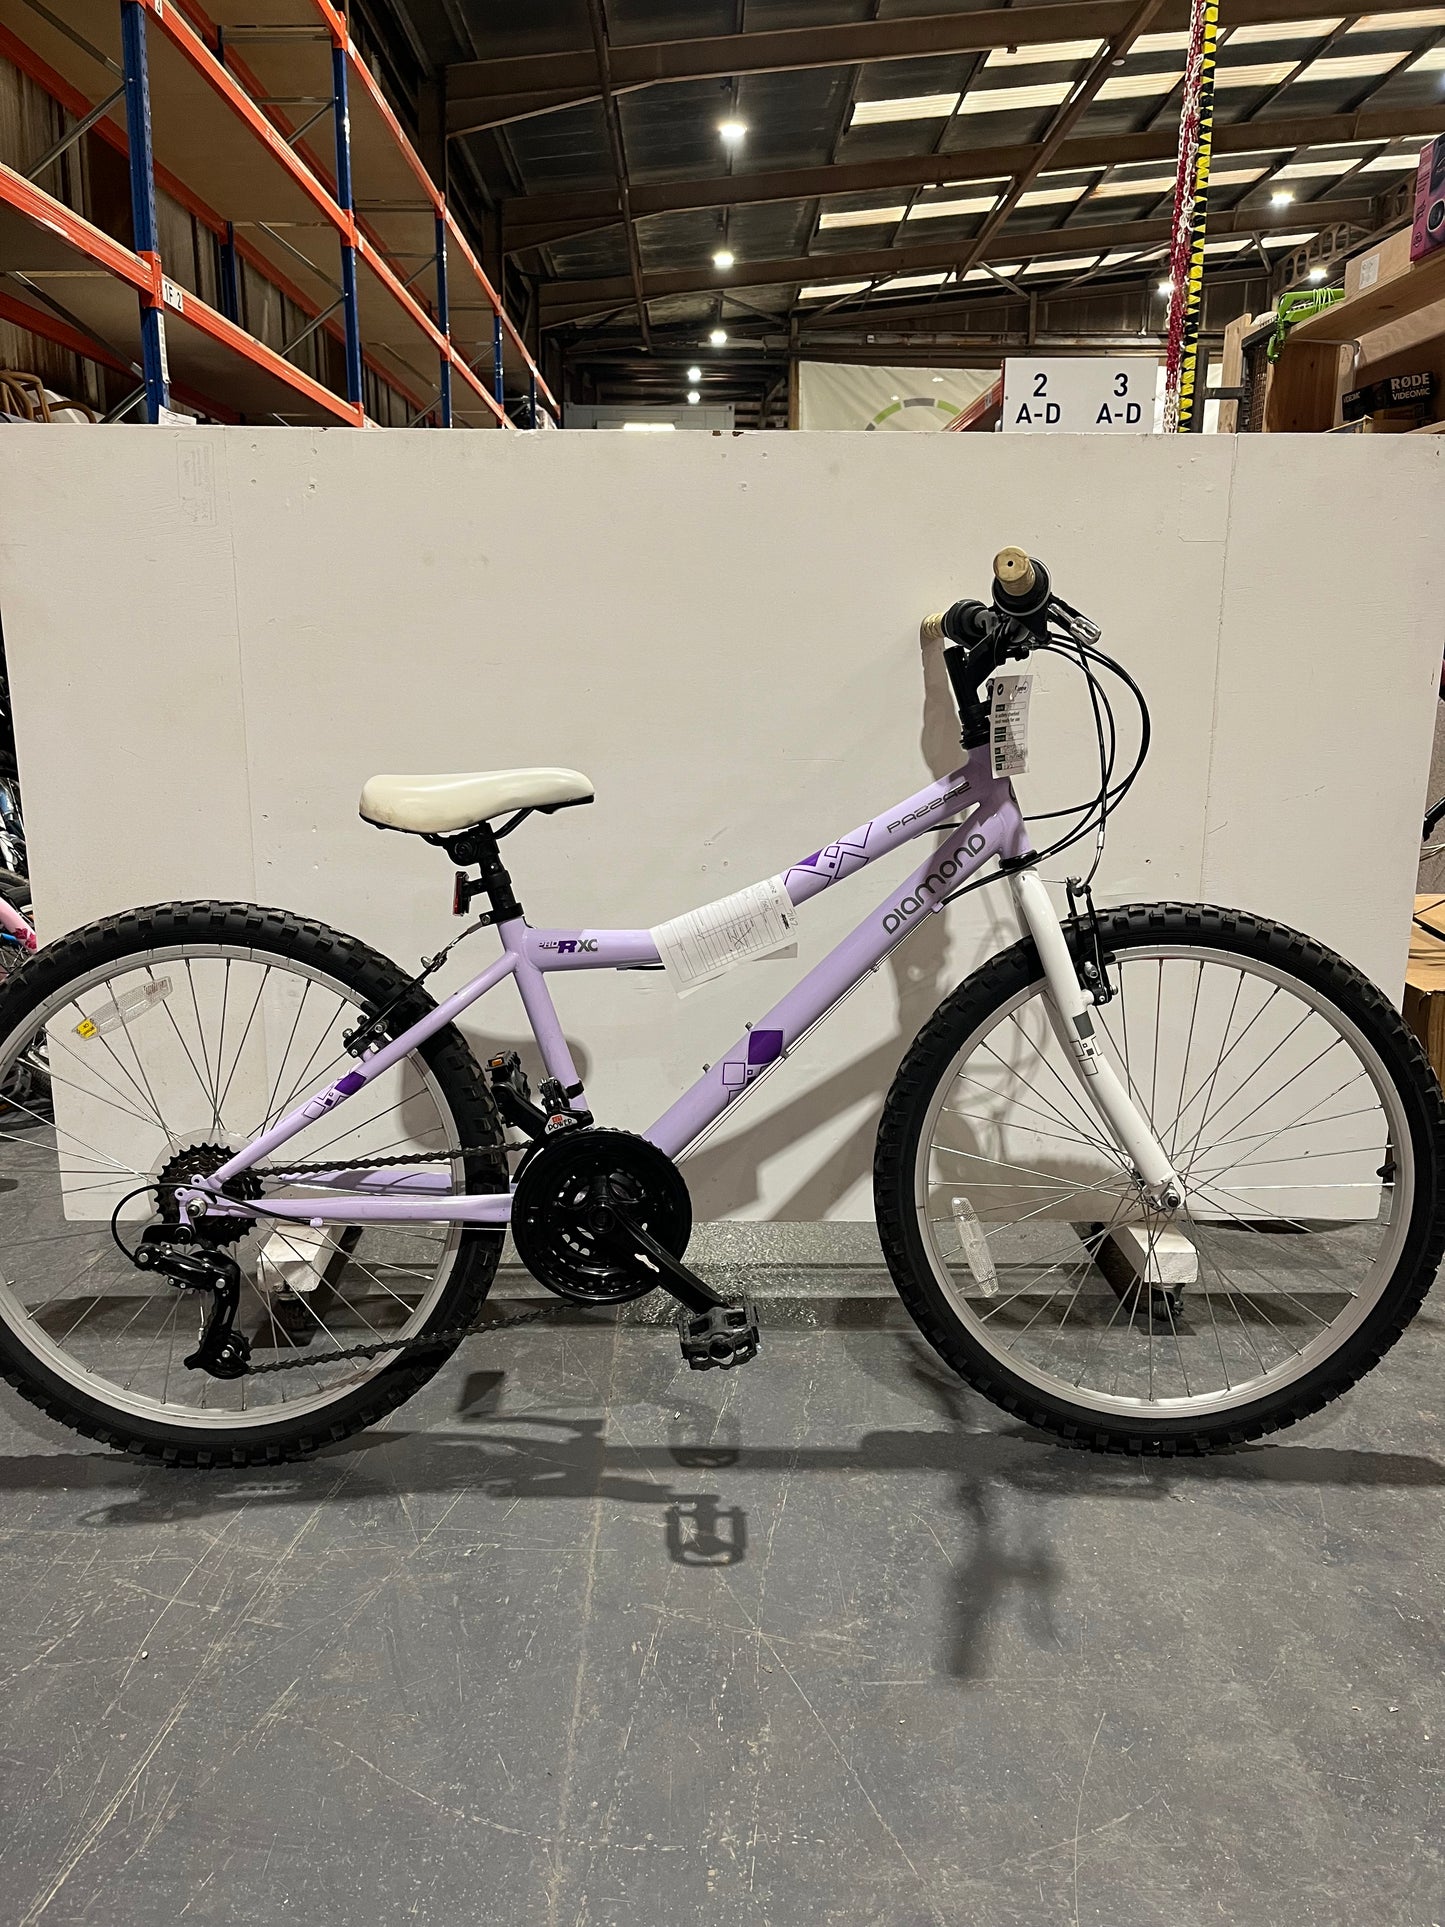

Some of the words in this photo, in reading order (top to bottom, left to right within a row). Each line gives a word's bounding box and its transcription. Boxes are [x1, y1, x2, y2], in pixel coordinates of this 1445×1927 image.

[177, 292, 182, 309] 2
[1033, 373, 1048, 397] 2
[1113, 373, 1129, 397] 3
[1390, 372, 1430, 391] RØDE
[1392, 387, 1431, 401] VIDEOMIC
[1015, 402, 1061, 424] A-D
[1095, 402, 1142, 424] A-D
[548, 1118, 573, 1131] POWER
